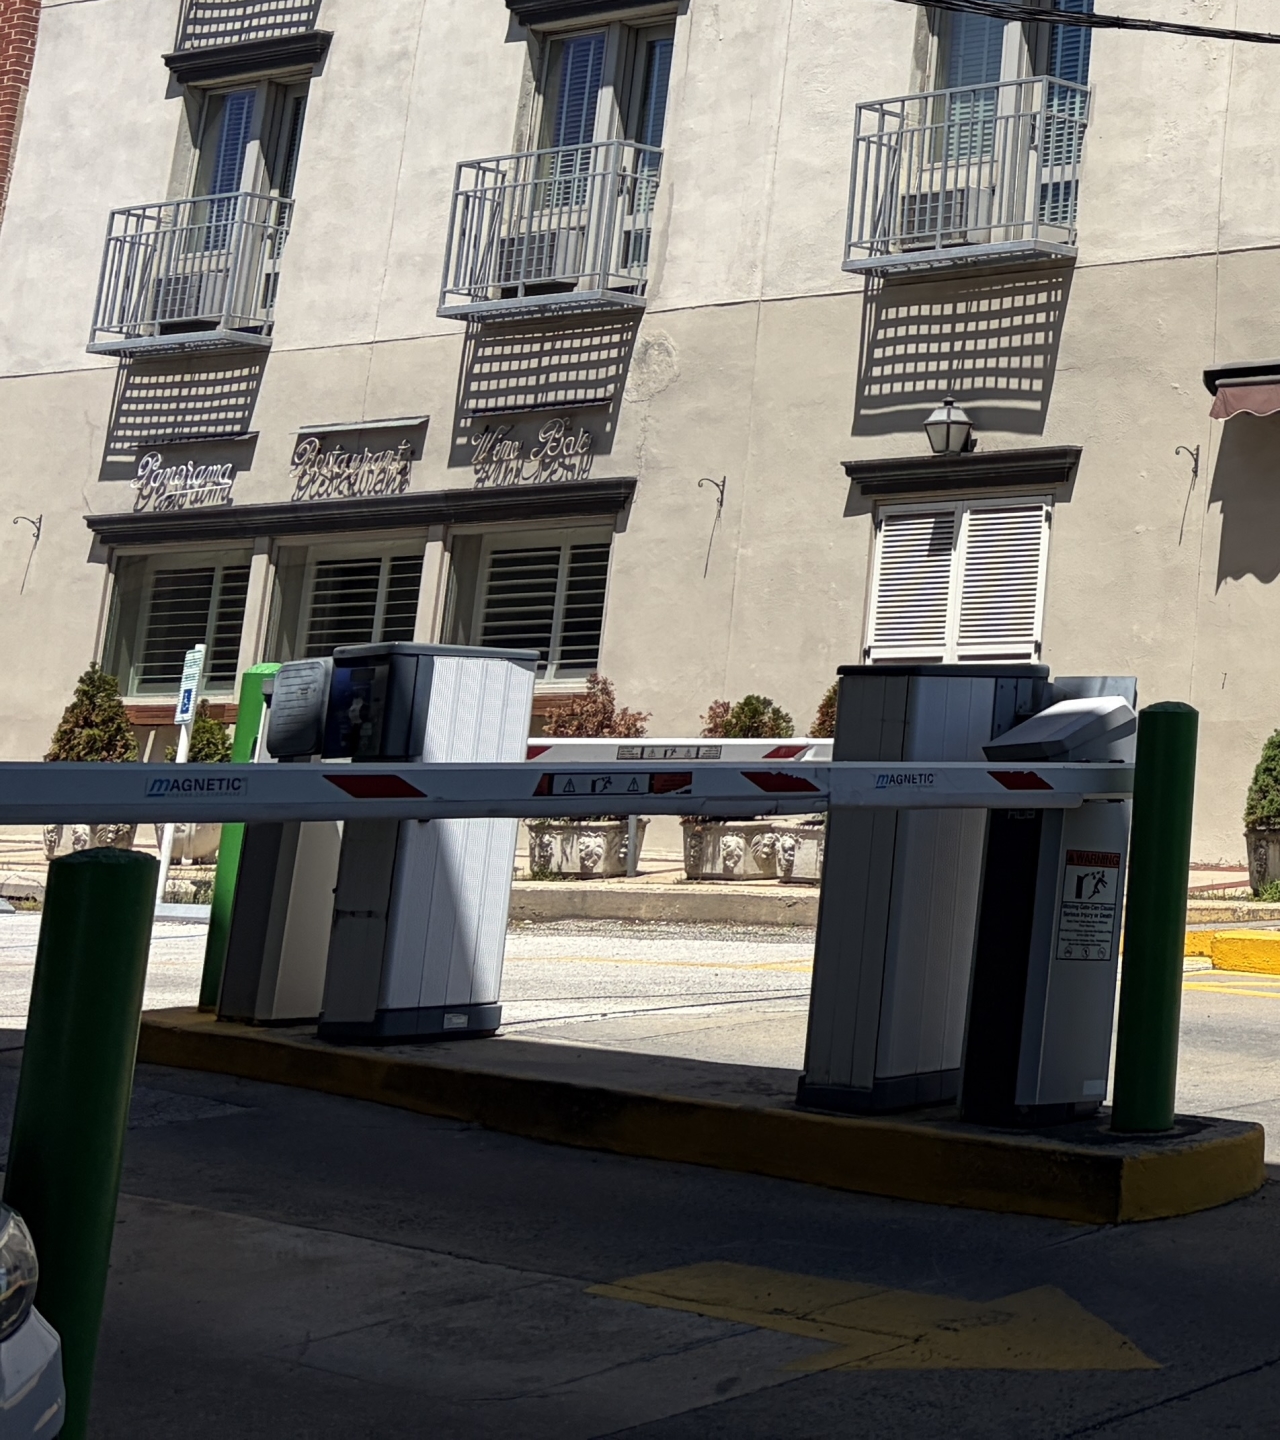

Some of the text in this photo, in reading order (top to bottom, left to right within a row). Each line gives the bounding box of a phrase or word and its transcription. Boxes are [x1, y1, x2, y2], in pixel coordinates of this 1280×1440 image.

[130, 451, 233, 497] Panorama
[289, 436, 412, 478] Restaurant
[1075, 850, 1120, 867] WARNING
